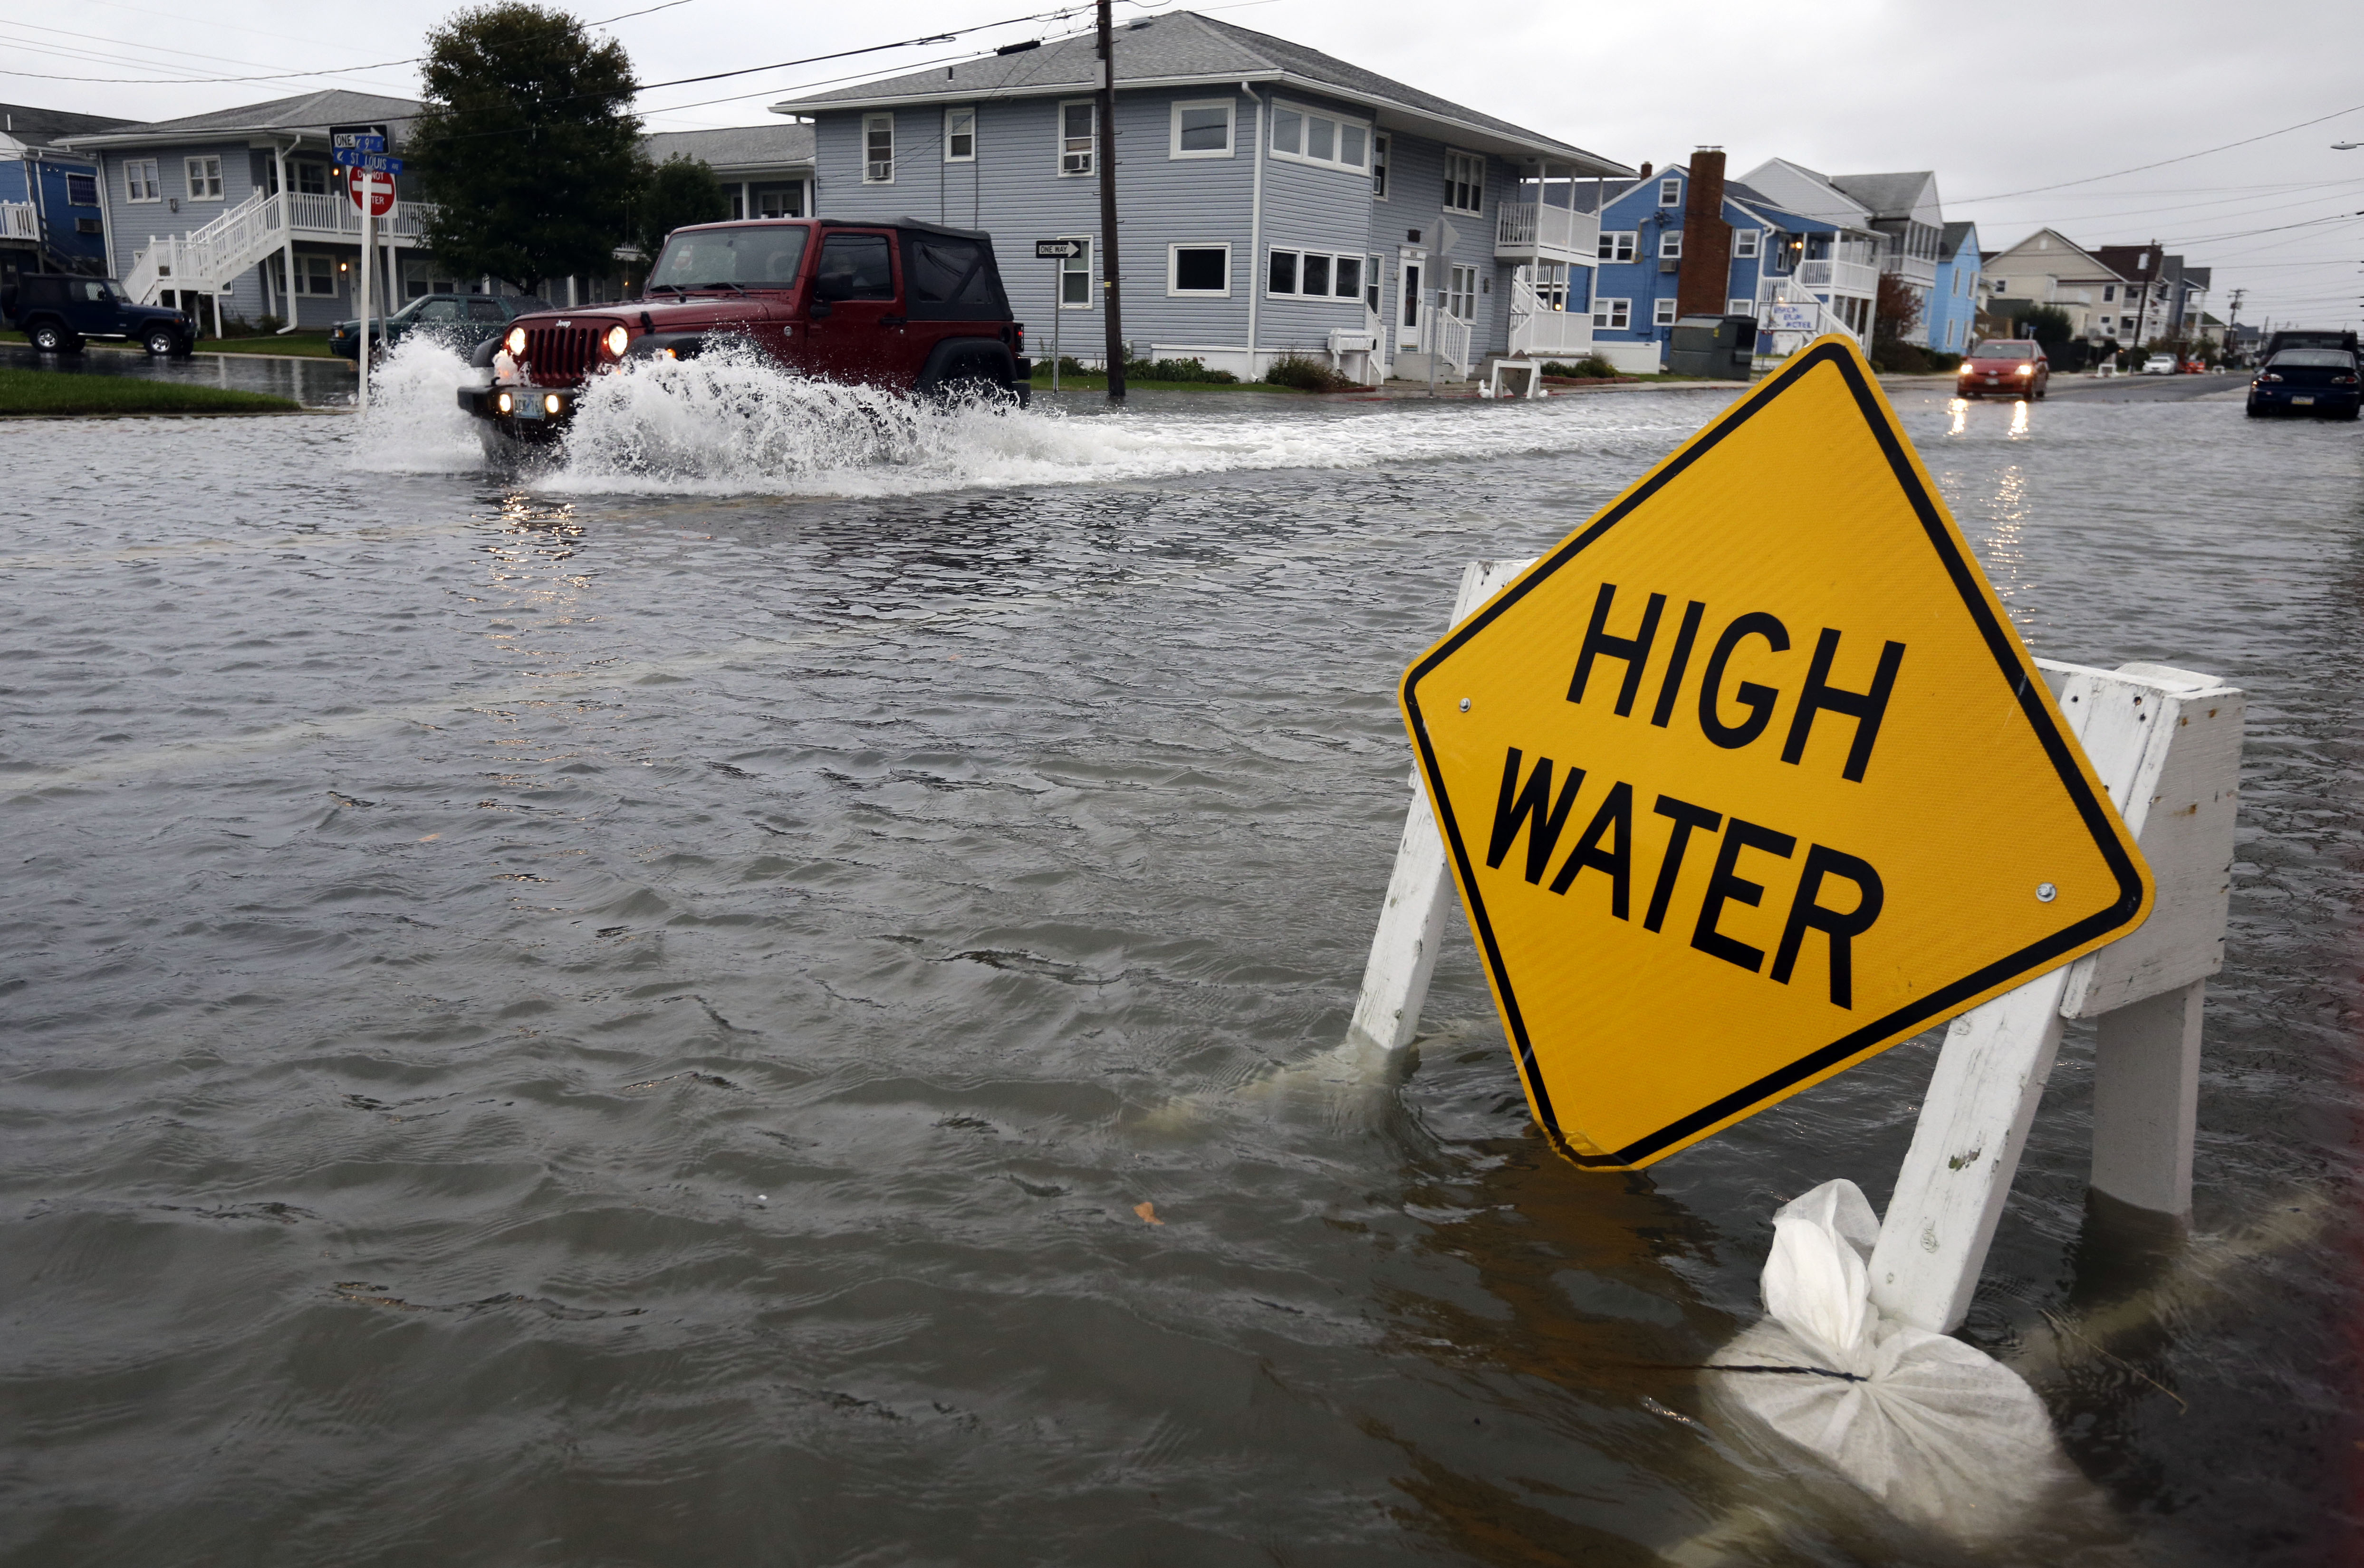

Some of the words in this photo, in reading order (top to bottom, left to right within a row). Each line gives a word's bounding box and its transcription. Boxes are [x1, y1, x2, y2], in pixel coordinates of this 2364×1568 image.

[336, 134, 352, 146] ONE
[351, 152, 359, 165] ST
[365, 155, 387, 171] LOUIS
[357, 170, 363, 178] D
[371, 195, 384, 205] TER
[556, 320, 571, 328] Jeep
[1566, 583, 1906, 784] HIGH
[1486, 746, 1884, 1011] WATER
